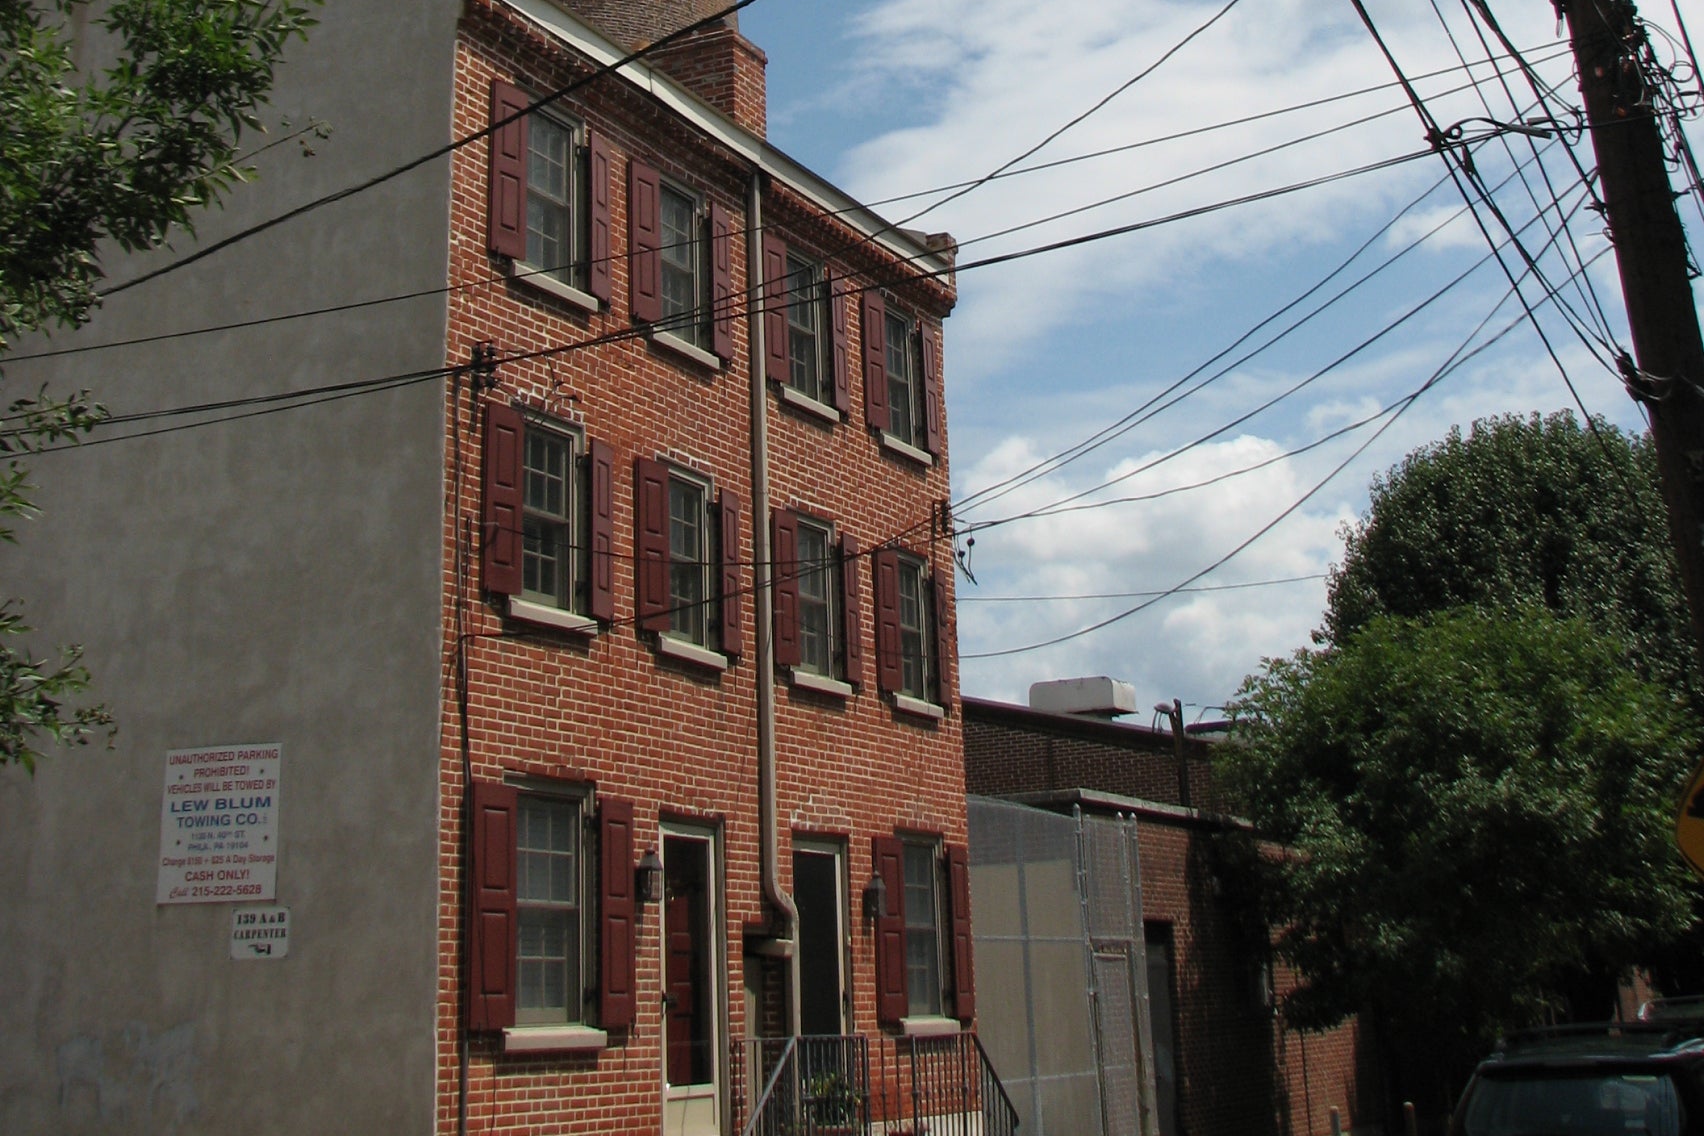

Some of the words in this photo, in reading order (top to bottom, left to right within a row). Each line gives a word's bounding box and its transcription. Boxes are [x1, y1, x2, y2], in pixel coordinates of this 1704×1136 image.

[169, 752, 234, 765] UNAUTHORIZED
[237, 749, 278, 761] PARKING
[194, 765, 250, 778] PROHIBITED!
[167, 782, 202, 794] VEHICLES
[204, 782, 220, 792] WILL
[222, 781, 233, 791] BE
[235, 779, 264, 790] TOWED
[266, 779, 275, 789] BY
[171, 800, 209, 813] LEW
[215, 796, 271, 810] BLUM
[177, 814, 230, 828] TOWING
[236, 813, 261, 825] CO.
[162, 857, 186, 867] Charge
[225, 855, 231, 863] A
[233, 854, 246, 865] Day
[248, 853, 275, 864] Storage
[185, 870, 213, 881] CASH
[217, 869, 250, 880] ONLY!
[191, 884, 262, 896] 215-222-5628
[237, 913, 256, 925] 139
[259, 912, 266, 923] A
[233, 928, 286, 940] CARPENTER
